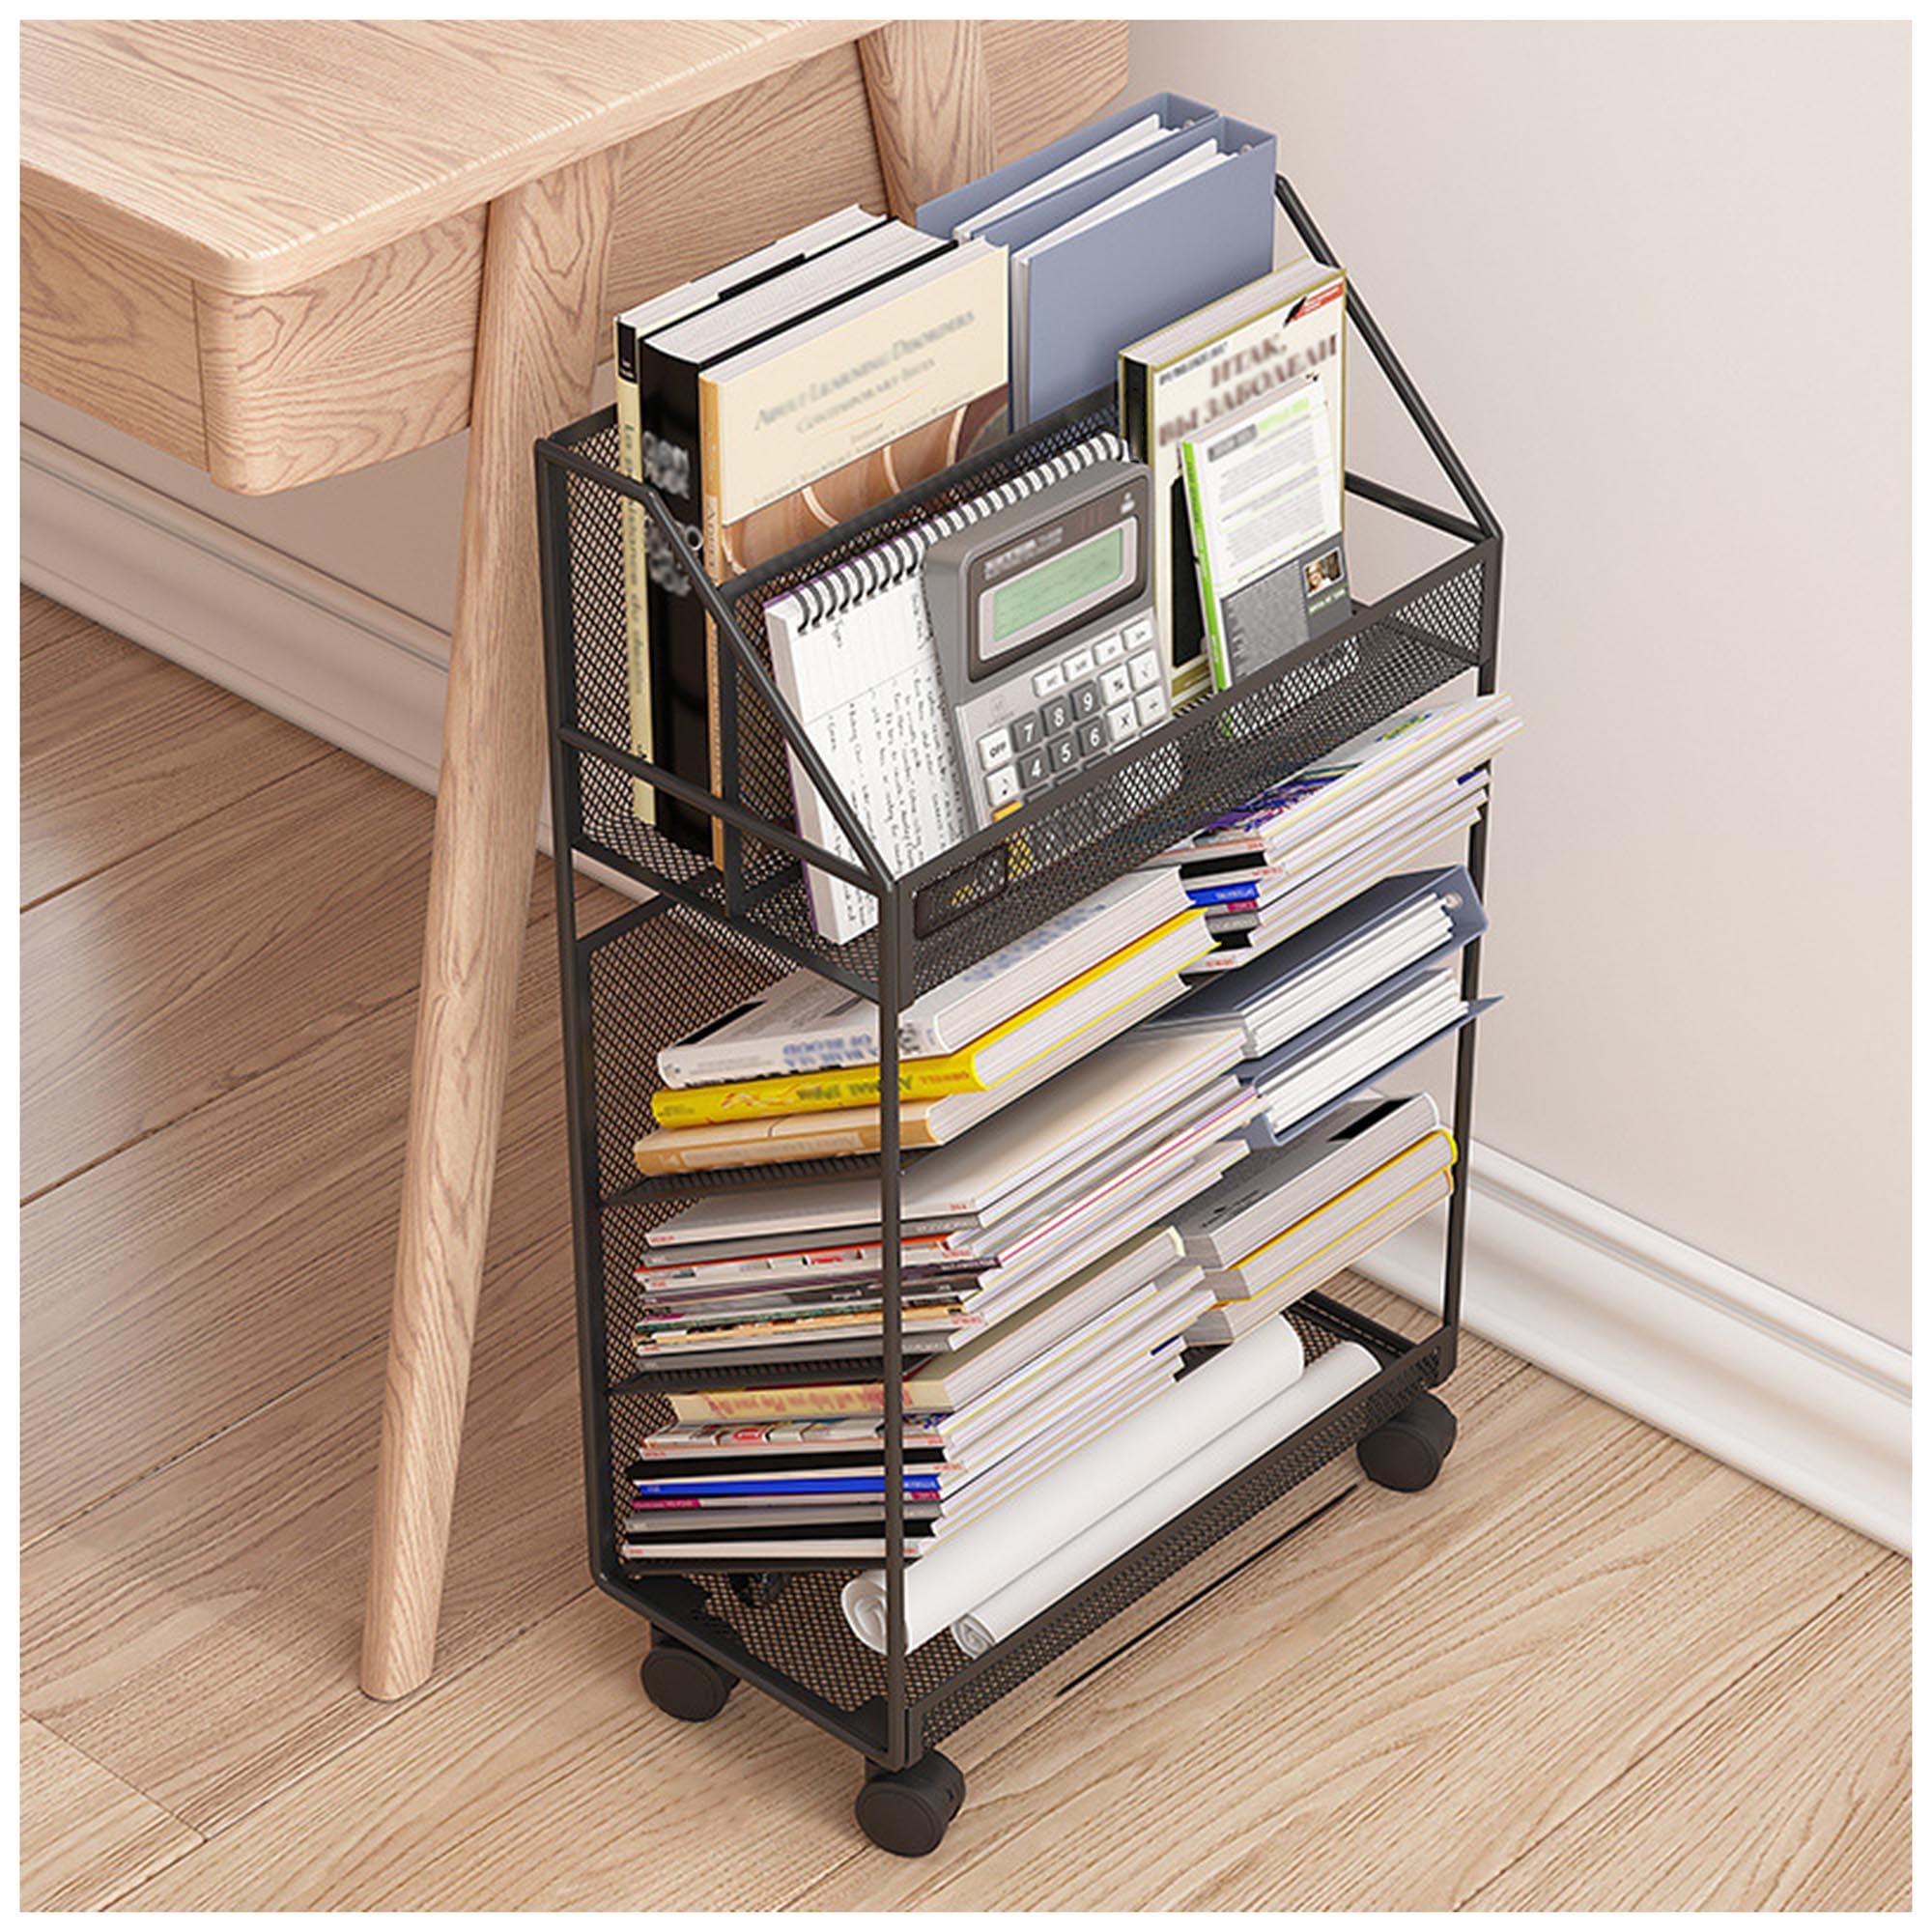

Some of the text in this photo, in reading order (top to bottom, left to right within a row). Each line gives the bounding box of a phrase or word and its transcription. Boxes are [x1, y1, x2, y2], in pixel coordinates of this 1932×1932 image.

[1024, 692, 1093, 743] 7 8 9
[1031, 758, 1041, 778] 4
[1062, 742, 1071, 763] 5
[1090, 726, 1101, 747] 6
